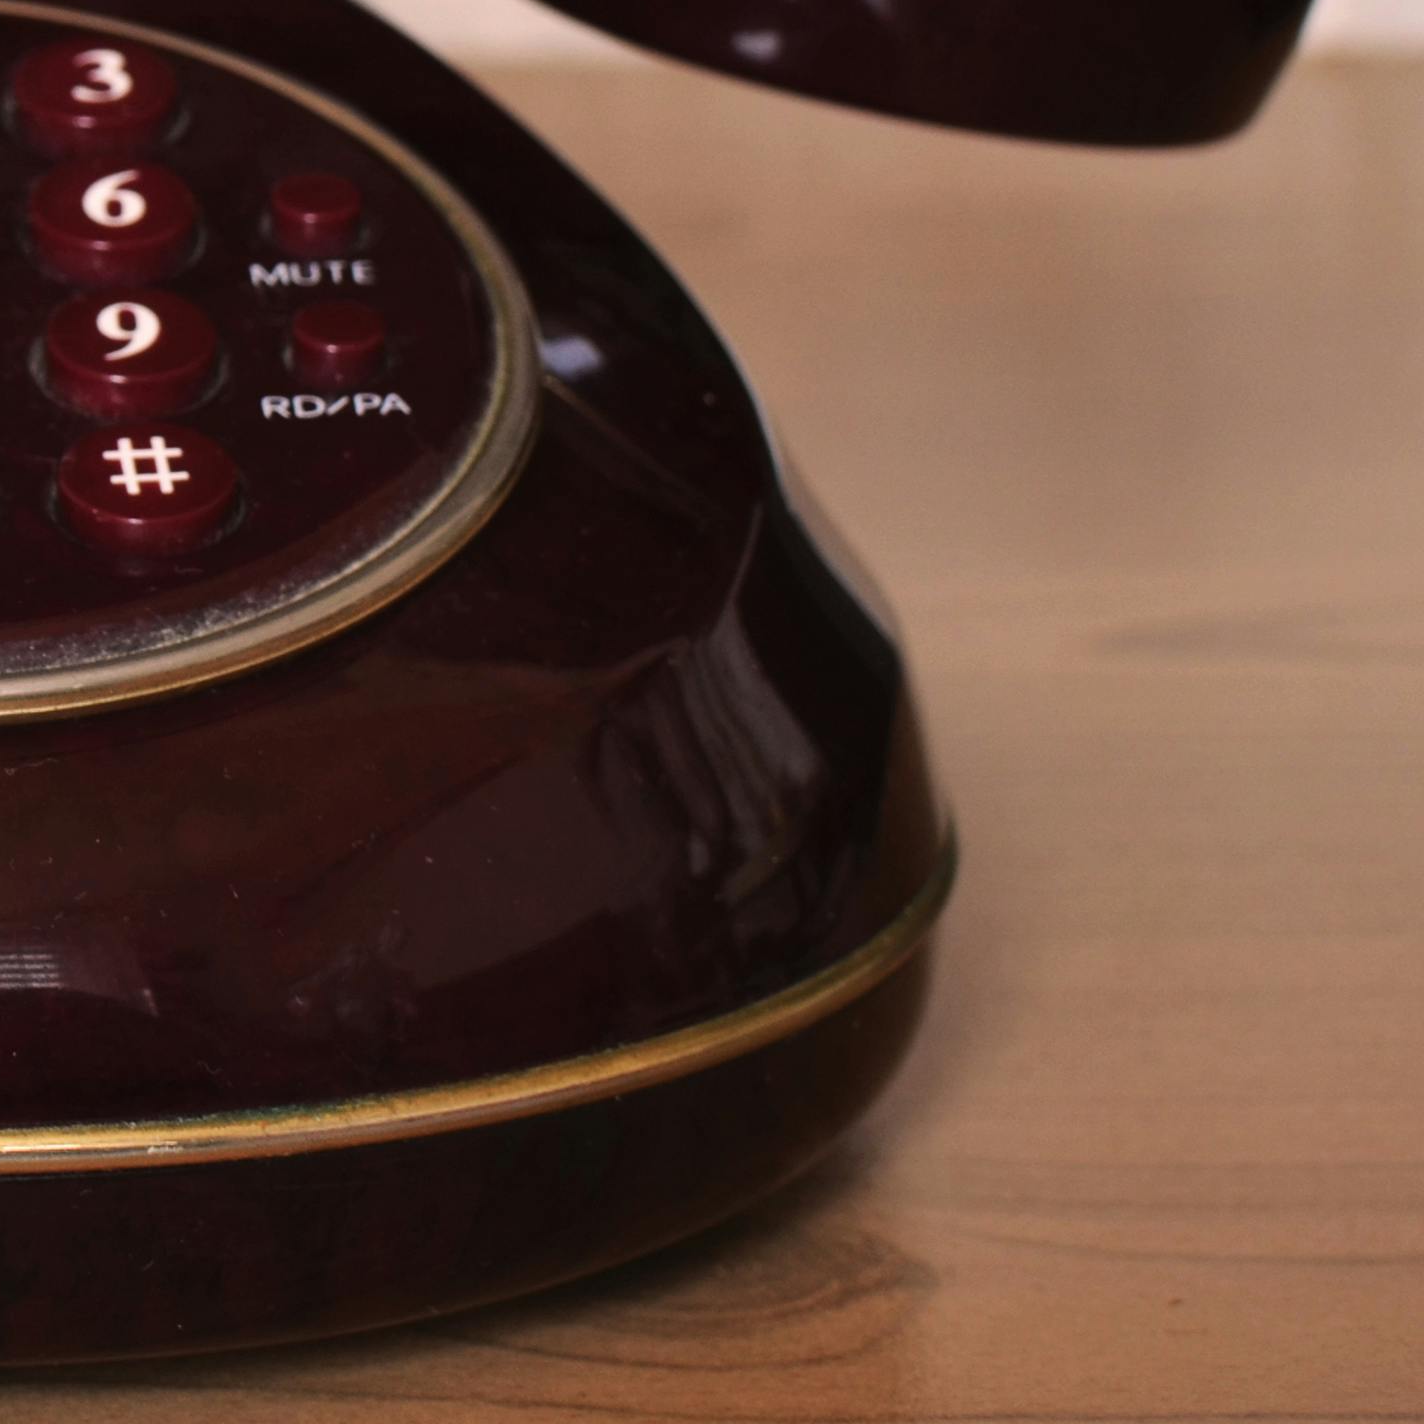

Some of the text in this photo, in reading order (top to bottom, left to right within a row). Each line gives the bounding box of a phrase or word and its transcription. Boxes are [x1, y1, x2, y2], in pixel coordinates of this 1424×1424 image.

[71, 49, 133, 102] 3
[81, 170, 147, 227] 6
[248, 259, 372, 287] MUTE
[95, 302, 161, 360] 9
[260, 392, 412, 420] RD/PA
